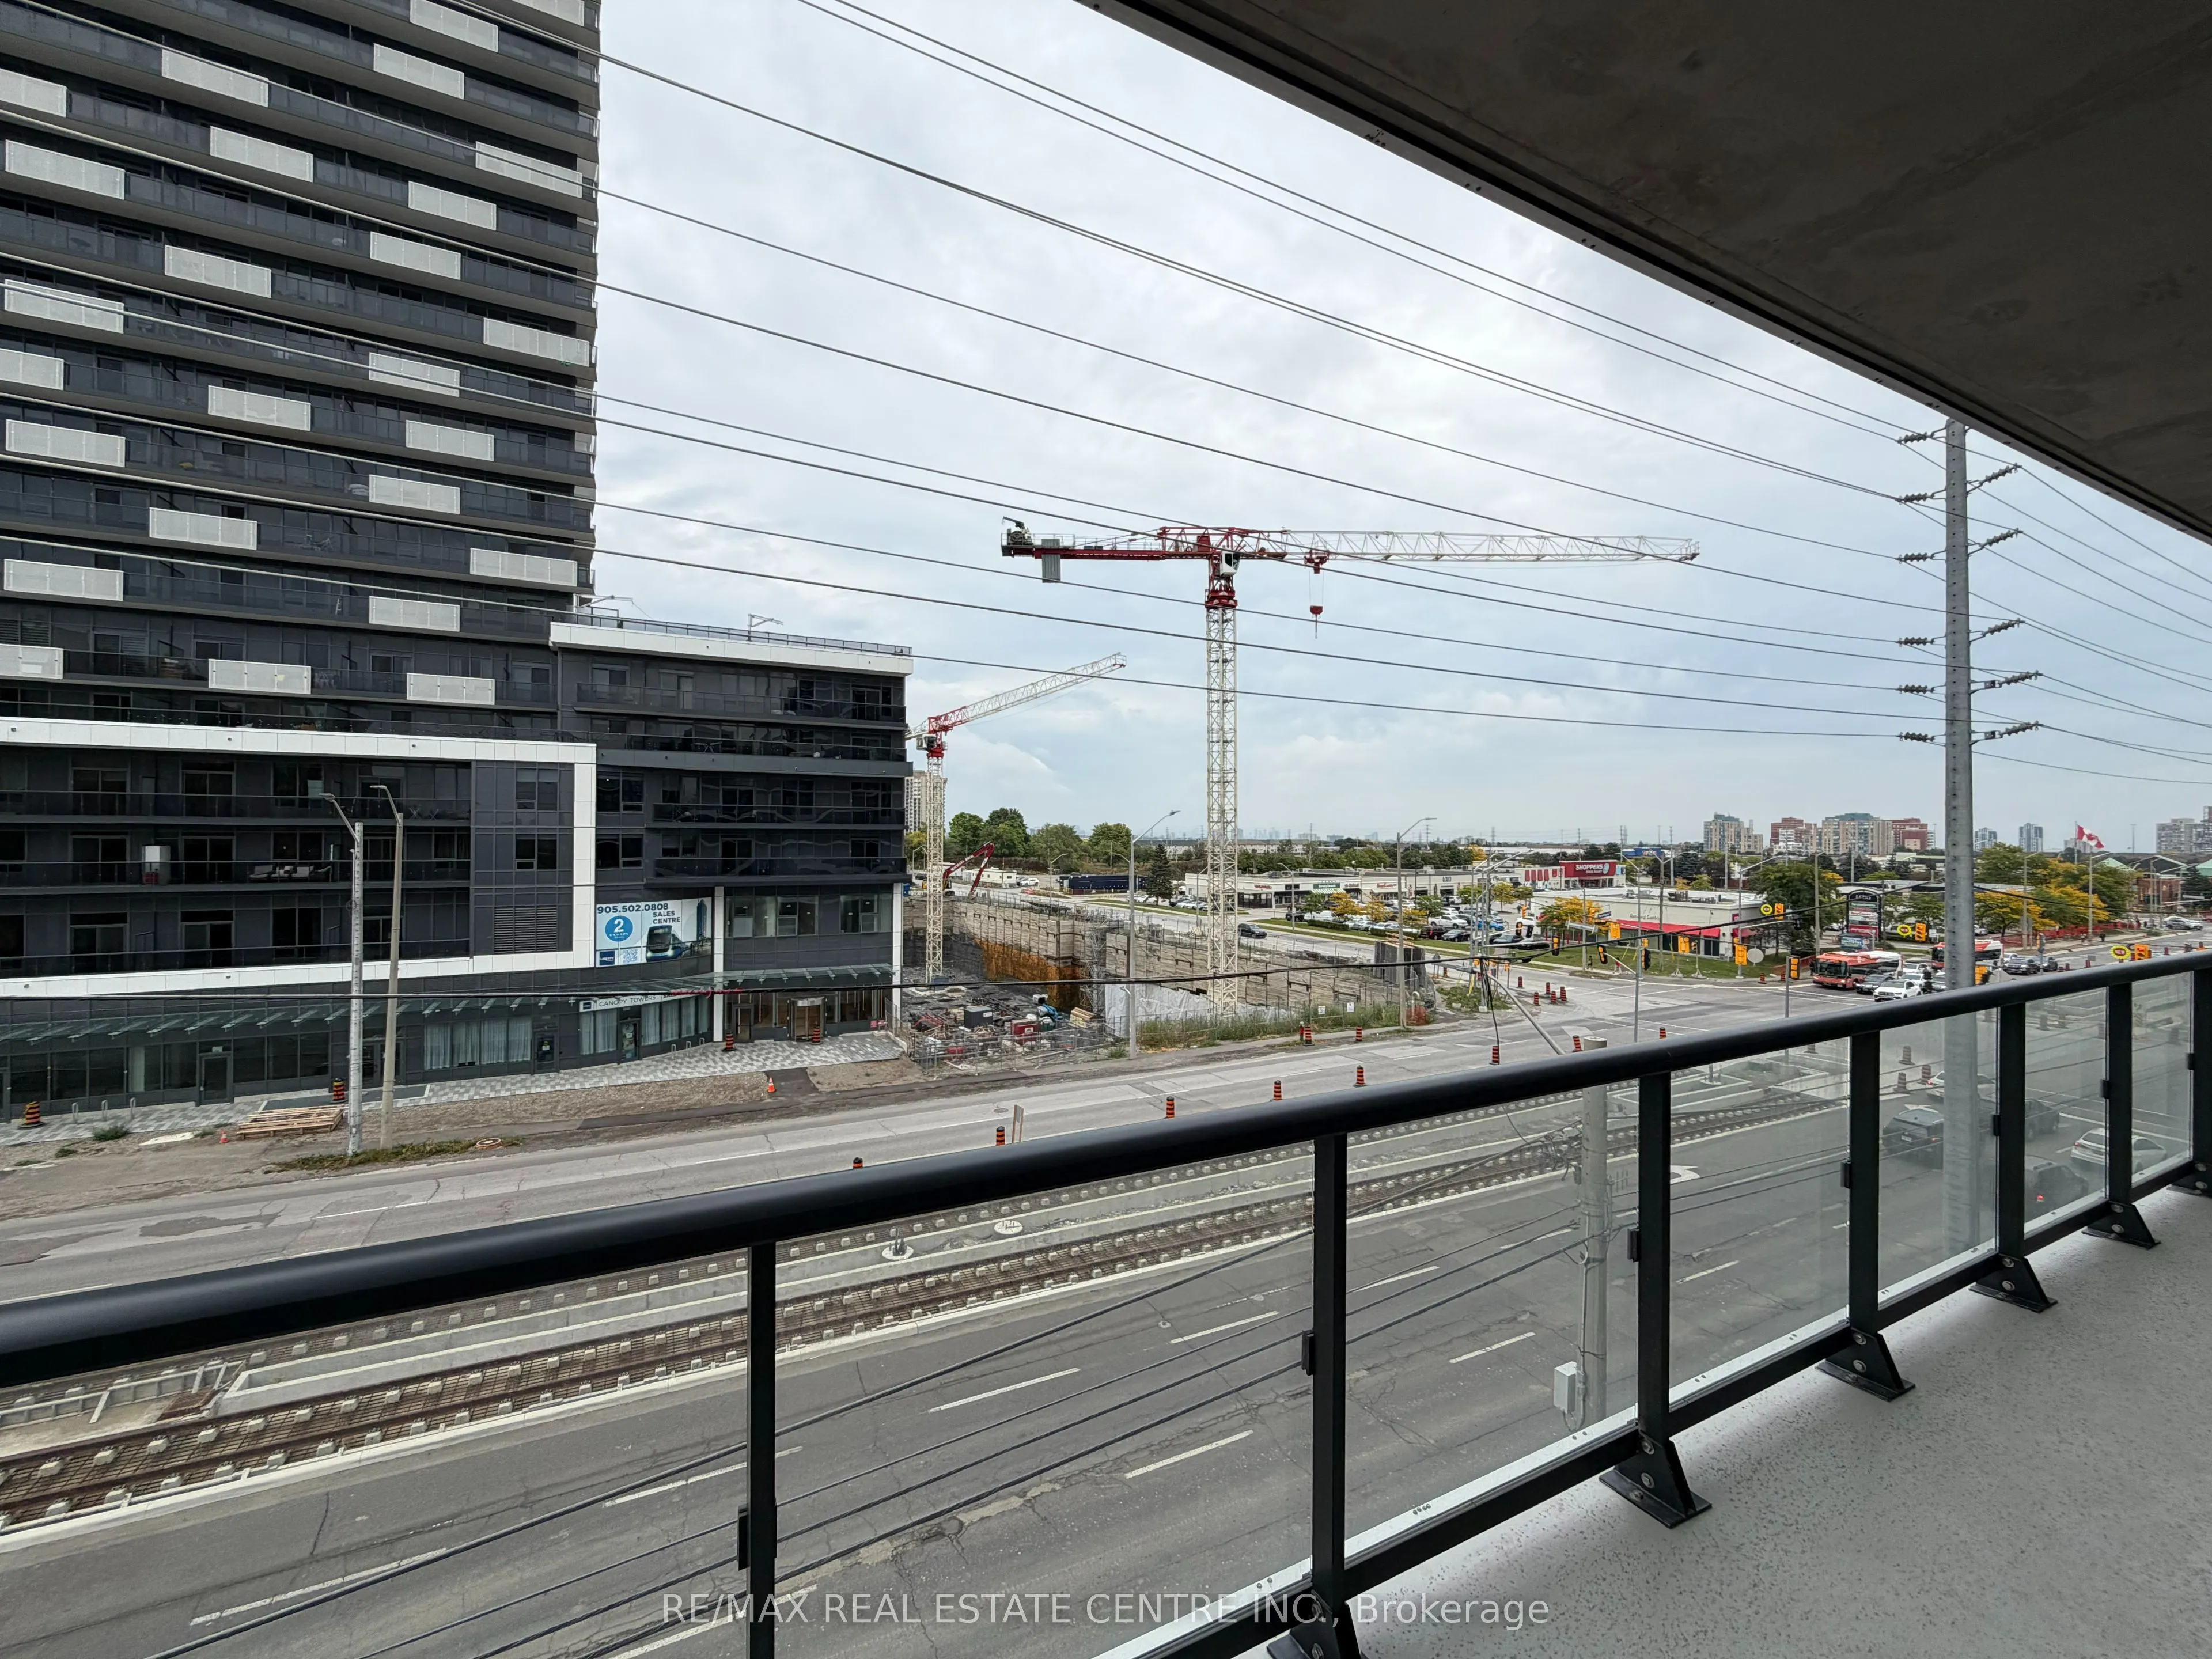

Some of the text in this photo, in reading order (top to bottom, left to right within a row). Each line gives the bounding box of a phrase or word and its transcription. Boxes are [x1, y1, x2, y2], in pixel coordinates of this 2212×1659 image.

[597, 903, 669, 914] 905.502.0808
[614, 919, 624, 933] 2
[599, 998, 627, 1007] CANOPY
[631, 995, 656, 1003] TOWERS
